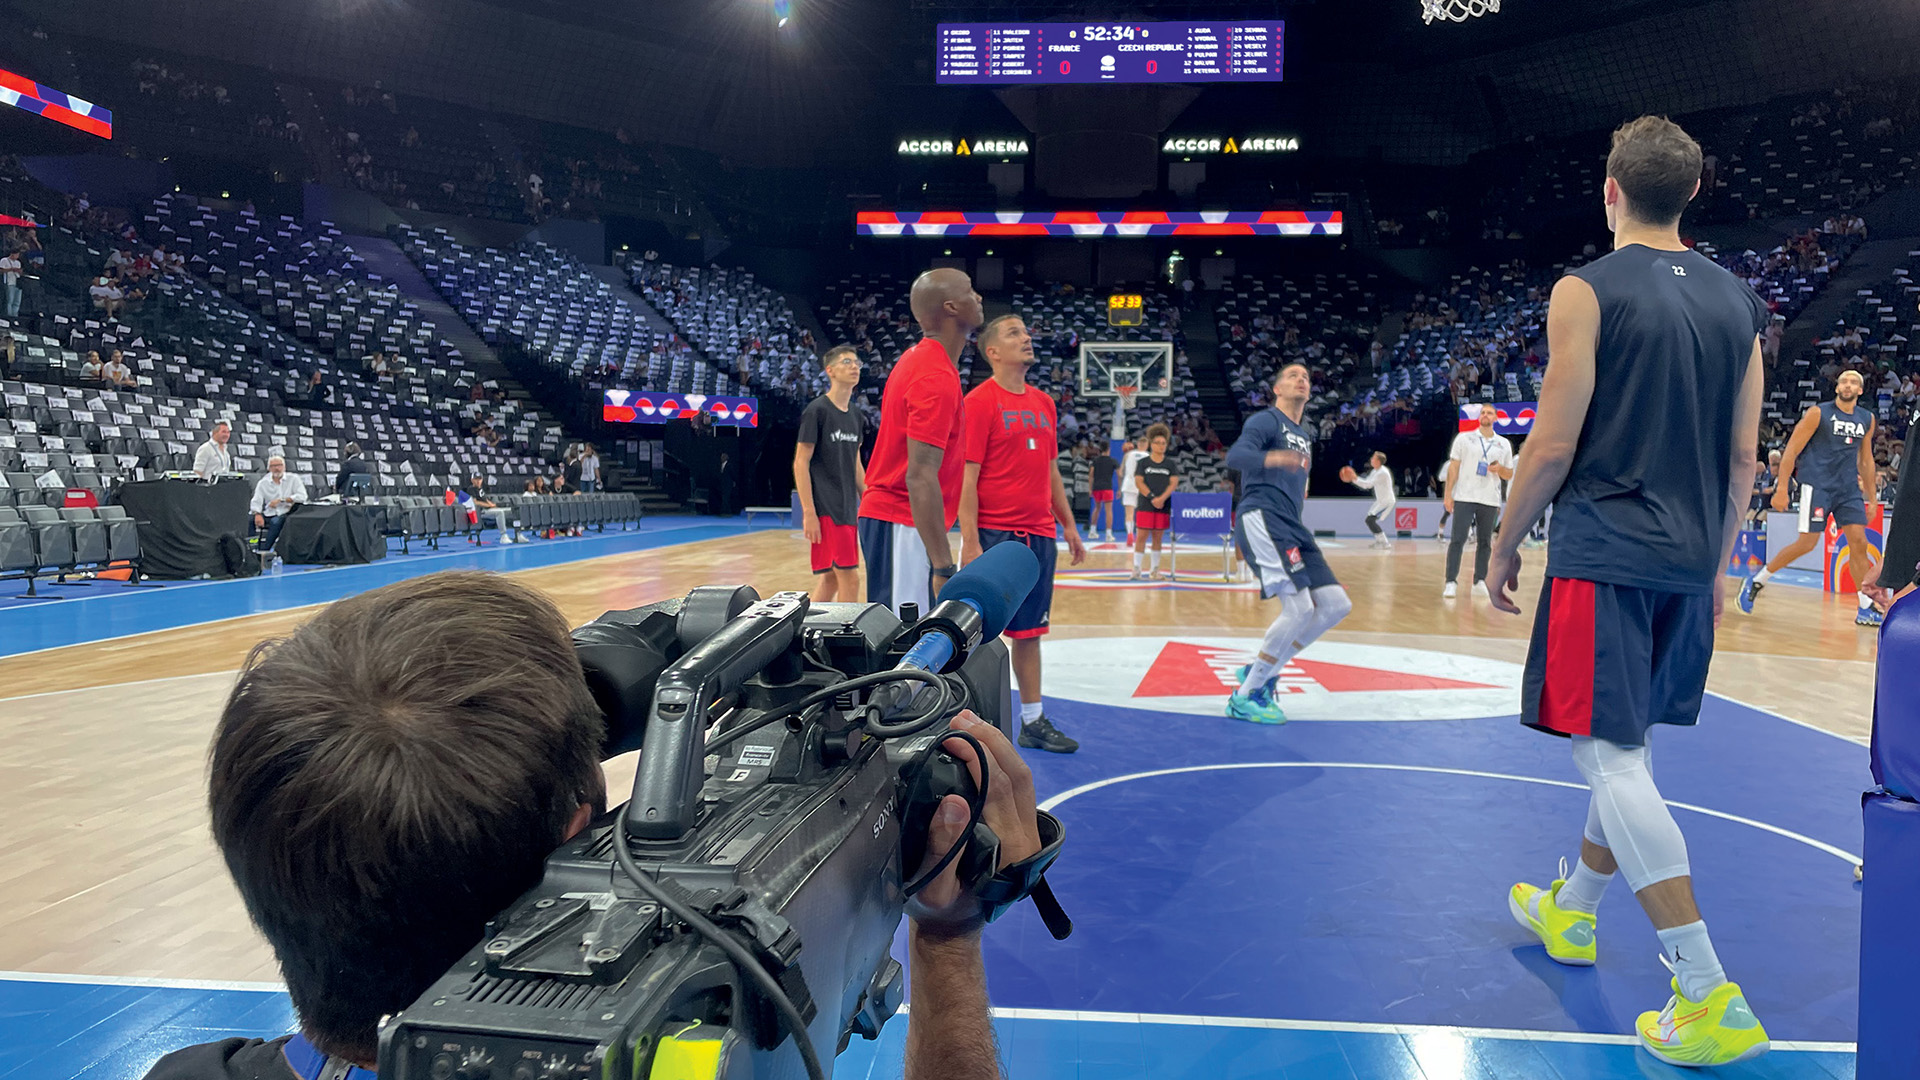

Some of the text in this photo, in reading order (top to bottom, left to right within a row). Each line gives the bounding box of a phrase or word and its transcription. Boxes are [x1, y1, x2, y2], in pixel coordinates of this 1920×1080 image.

[1084, 26, 1134, 41] 52:34
[1048, 44, 1081, 52] FRANCE
[1117, 43, 1184, 52] CZECH REPUBLIC
[1060, 60, 1071, 75] 0
[1146, 60, 1158, 74] 0
[898, 140, 1029, 153] ACCOR ARENA
[1163, 139, 1299, 151] ACCOR ARENA
[1671, 265, 1687, 276] 22
[1002, 410, 1051, 430] FRA
[1833, 420, 1865, 436] FRA
[1182, 507, 1224, 518] molten
[734, 771, 747, 780] F
[873, 796, 895, 840] SONY
